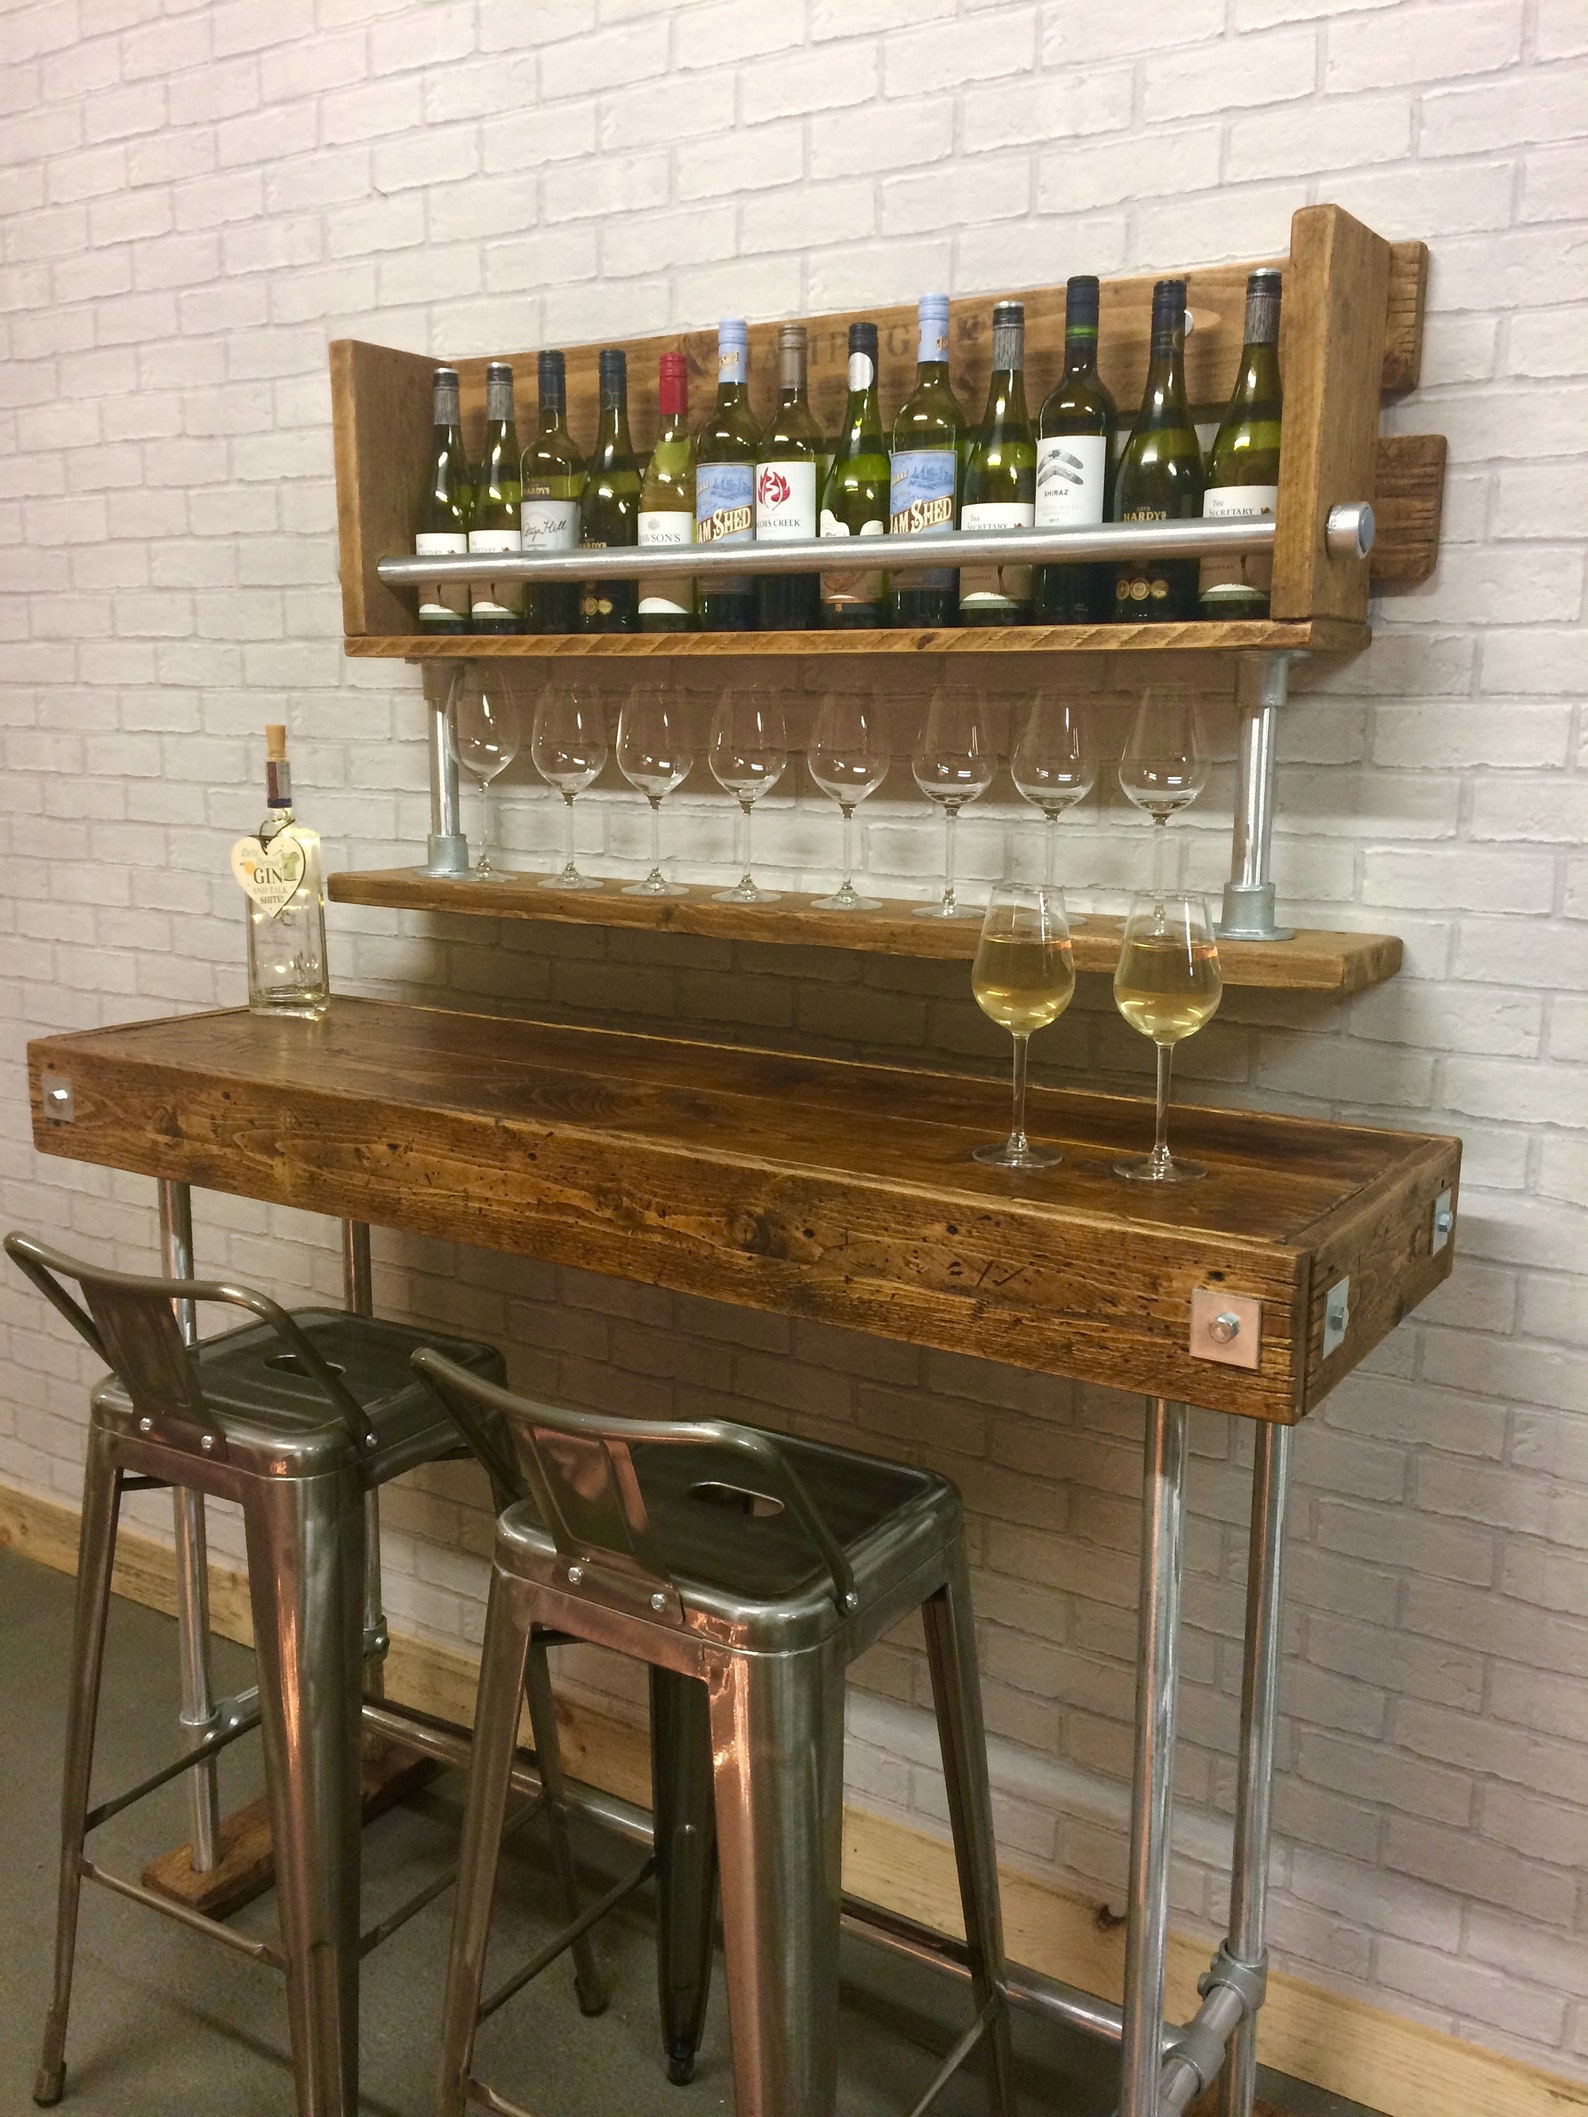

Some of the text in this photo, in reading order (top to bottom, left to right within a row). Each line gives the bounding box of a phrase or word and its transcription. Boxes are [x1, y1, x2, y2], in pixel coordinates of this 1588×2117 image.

[524, 486, 551, 495] ARDYS
[1043, 488, 1069, 498] SHIRAZ
[910, 498, 952, 533] SHED
[1122, 510, 1167, 522] HARDYS
[697, 508, 751, 543] AM SHED
[773, 518, 801, 527] CREEK
[253, 867, 283, 884] GIN
